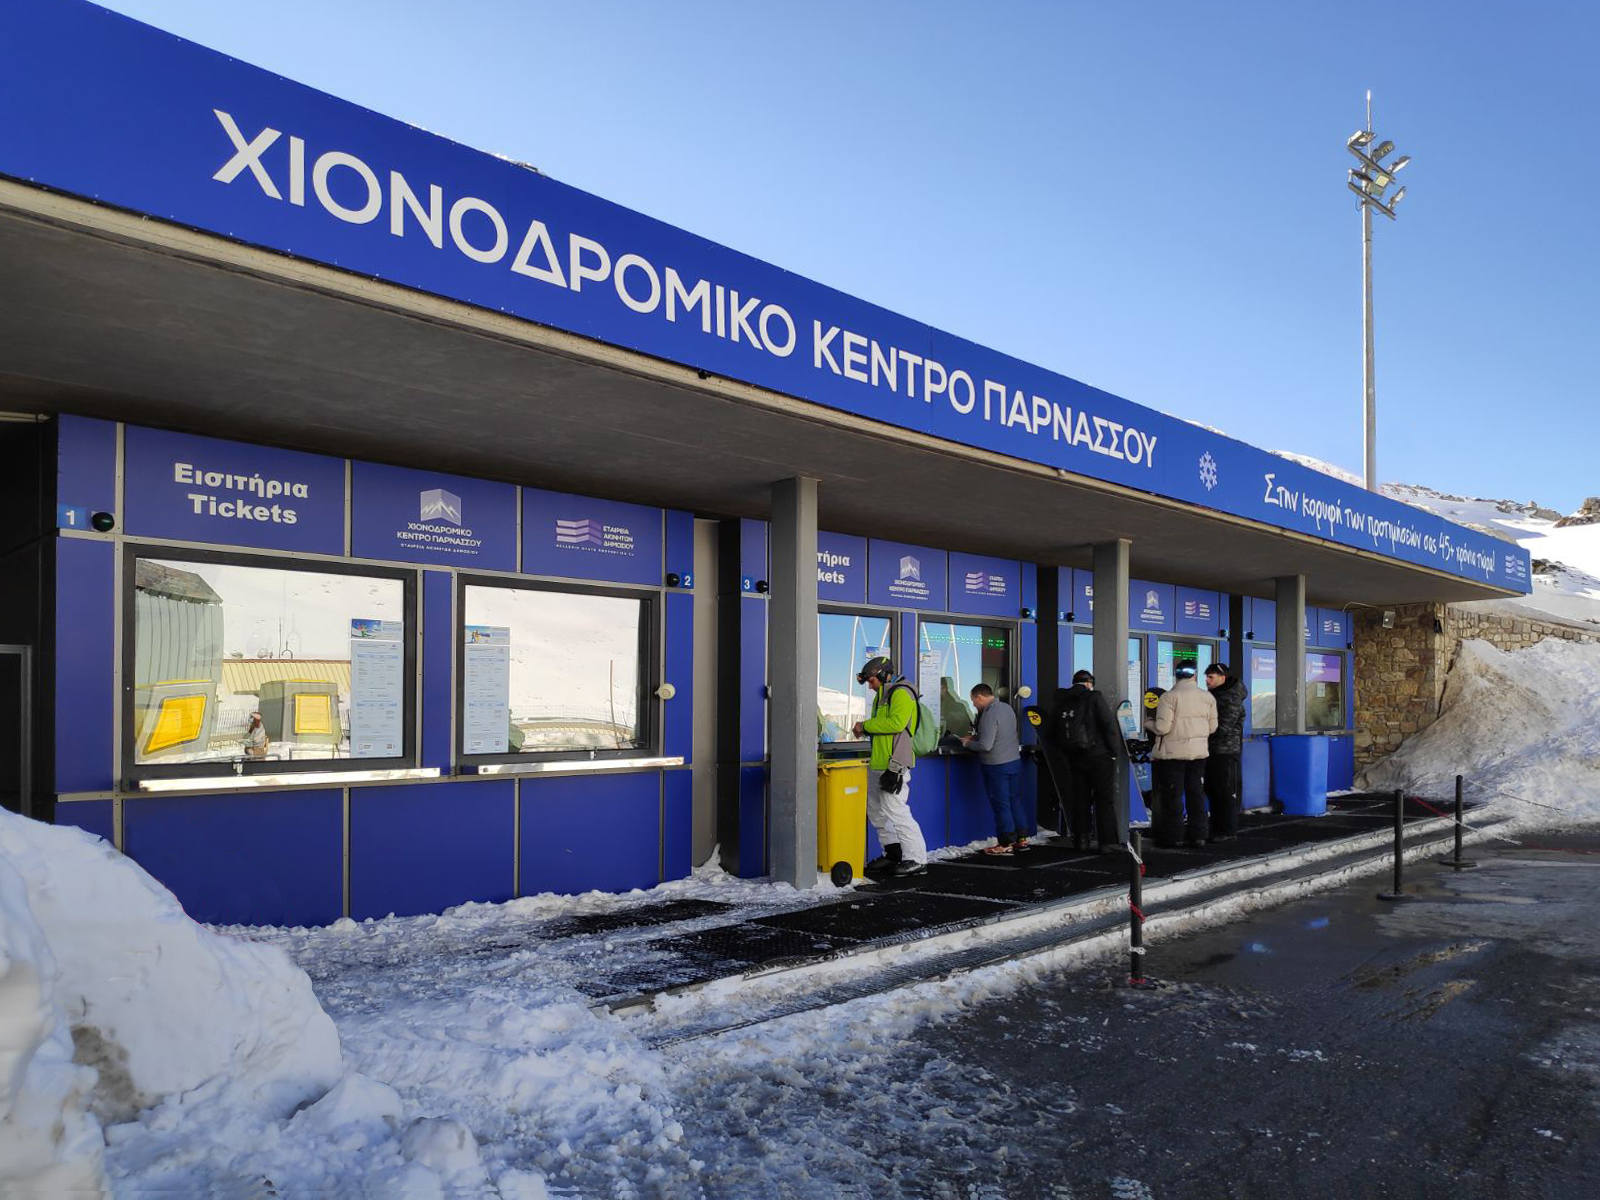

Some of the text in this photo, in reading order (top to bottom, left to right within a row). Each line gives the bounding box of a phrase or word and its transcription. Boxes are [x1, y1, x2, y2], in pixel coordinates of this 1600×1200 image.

[212, 108, 1157, 468] ΧΙΟΝΟΔΡΟΜΙΚΟ ΚΕΝΤΡΟ ΠΑΡΝΑΣΣΟΥ
[174, 462, 309, 498] Εισιτήρια
[65, 509, 75, 526] 1
[188, 493, 298, 525] Tickets
[408, 521, 472, 537] ΧΙΟΝΟΔΡΟΜΙΚΟ
[1264, 473, 1299, 512] Στην
[1302, 492, 1343, 537] κορυφή
[1344, 508, 1366, 532] των
[1423, 534, 1438, 555] σας
[1438, 532, 1455, 561] 45+
[1455, 542, 1477, 572] χρόνια
[396, 531, 482, 547] ΚΕΝΤΡΟ ΠΑΡΝΑΣΣΟΥ
[817, 550, 850, 568] τήρια
[684, 575, 691, 586] 2
[744, 579, 751, 590] 3
[817, 568, 846, 585] kets
